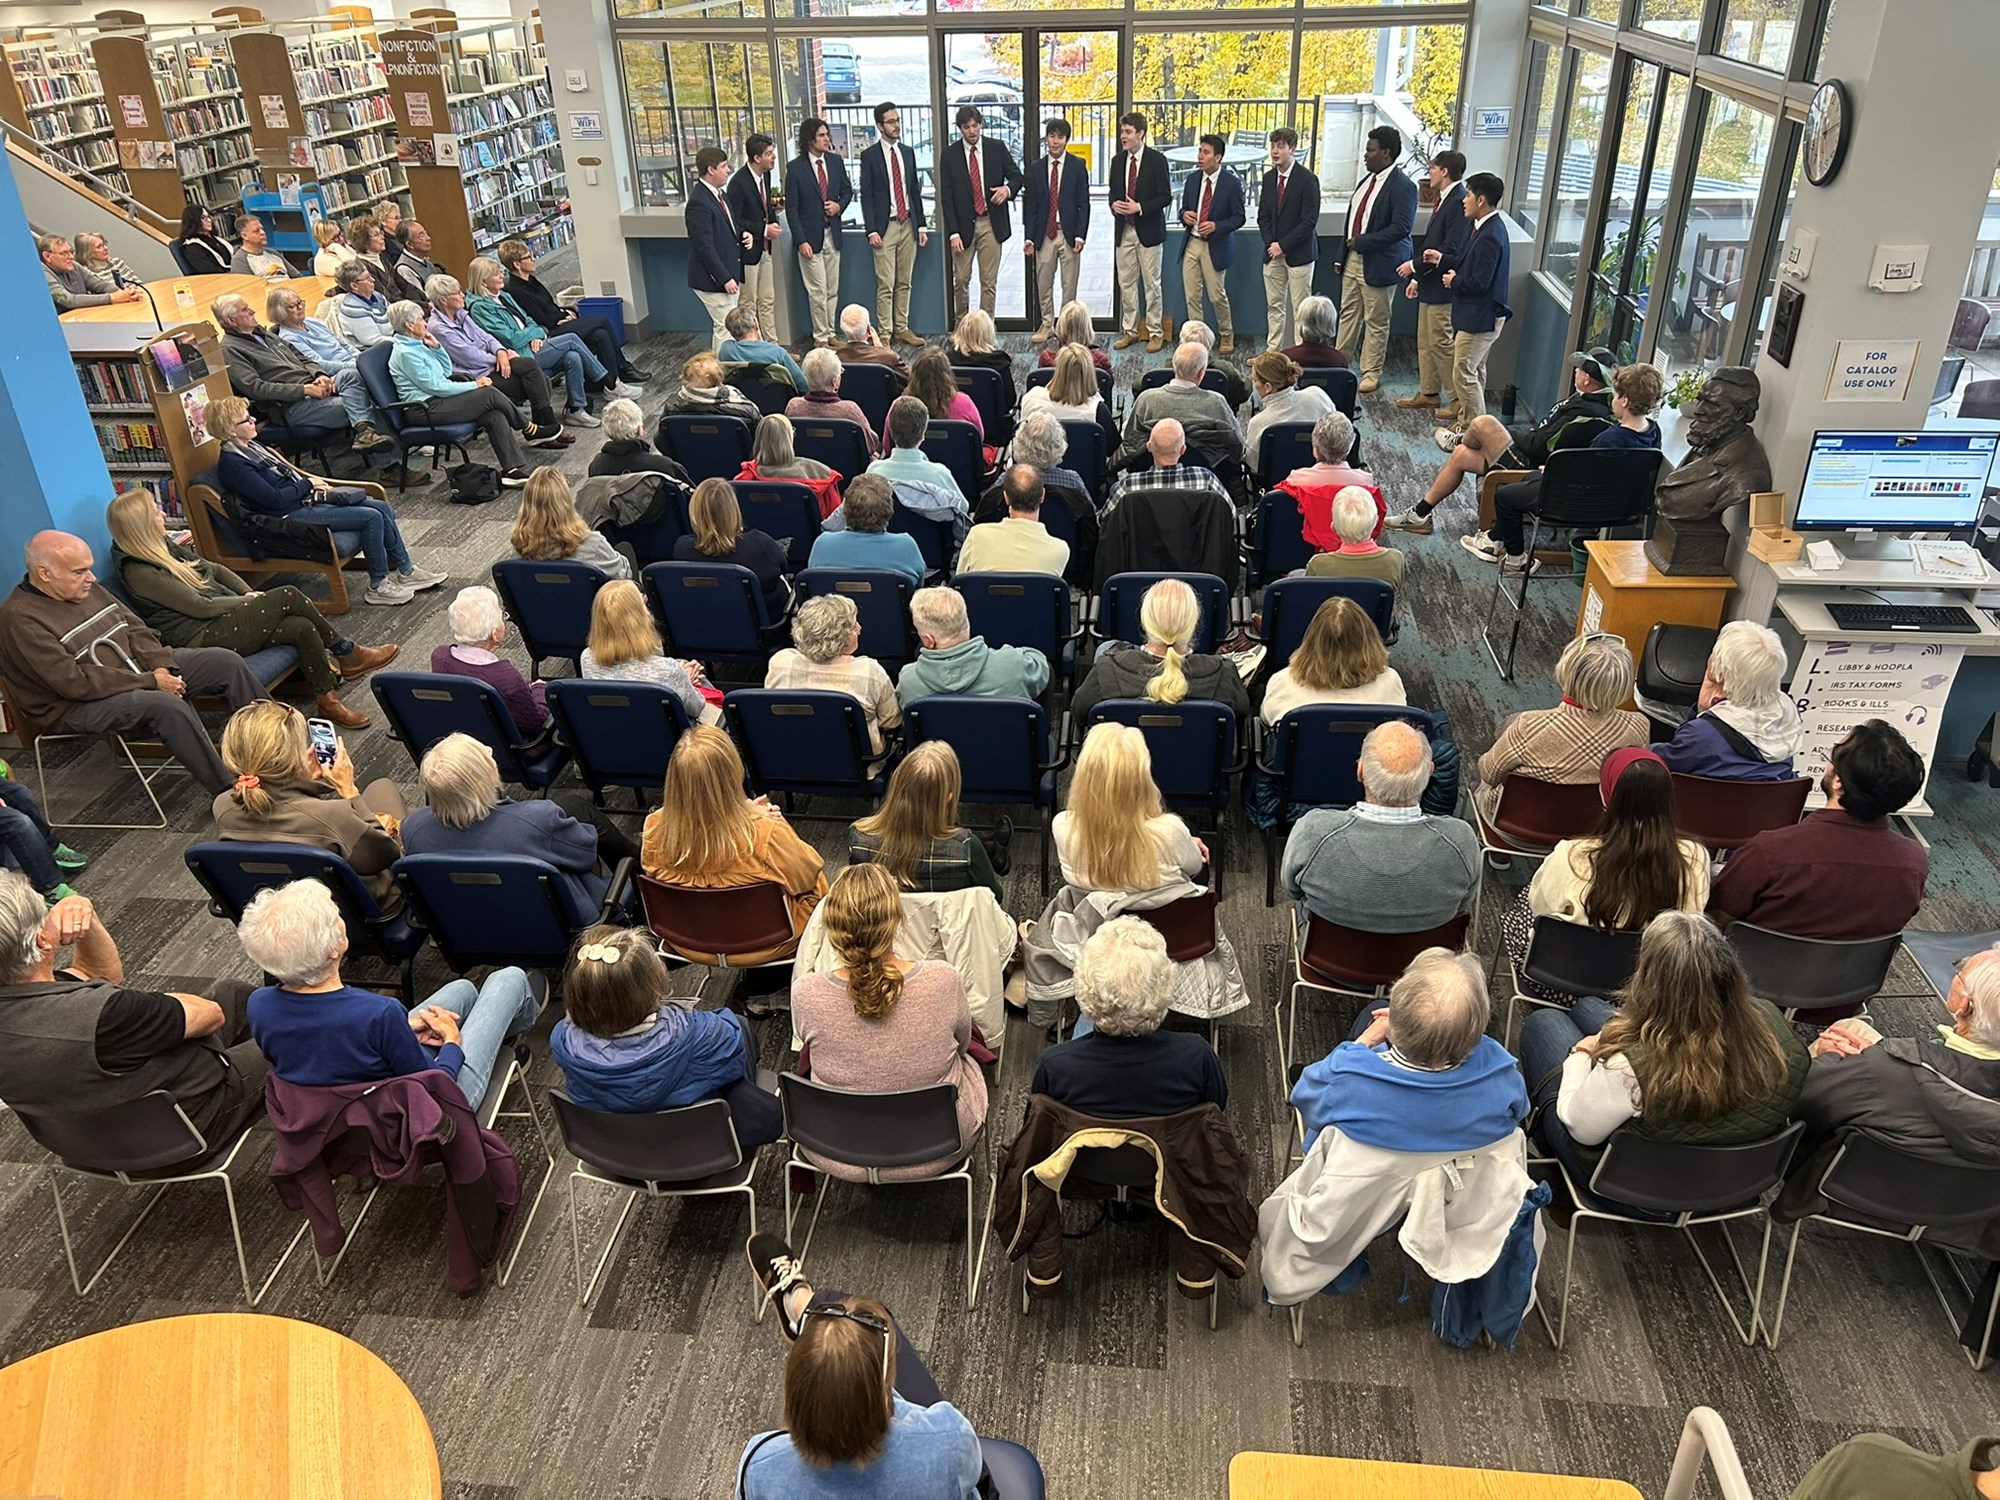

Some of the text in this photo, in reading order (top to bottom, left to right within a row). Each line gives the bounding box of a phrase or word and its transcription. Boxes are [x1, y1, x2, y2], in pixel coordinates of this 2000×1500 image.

[380, 40, 436, 52] NONFICTION
[407, 51, 417, 63] &
[1865, 352, 1887, 360] FOR
[1846, 366, 1897, 374] CATALOG
[1844, 379, 1896, 388] USE ONLY
[1830, 681, 1846, 689] IRS
[1848, 681, 1866, 689] TAX
[1869, 681, 1902, 689] FORMS
[1824, 700, 1858, 708] BOOKS
[1869, 700, 1889, 708] ILLS
